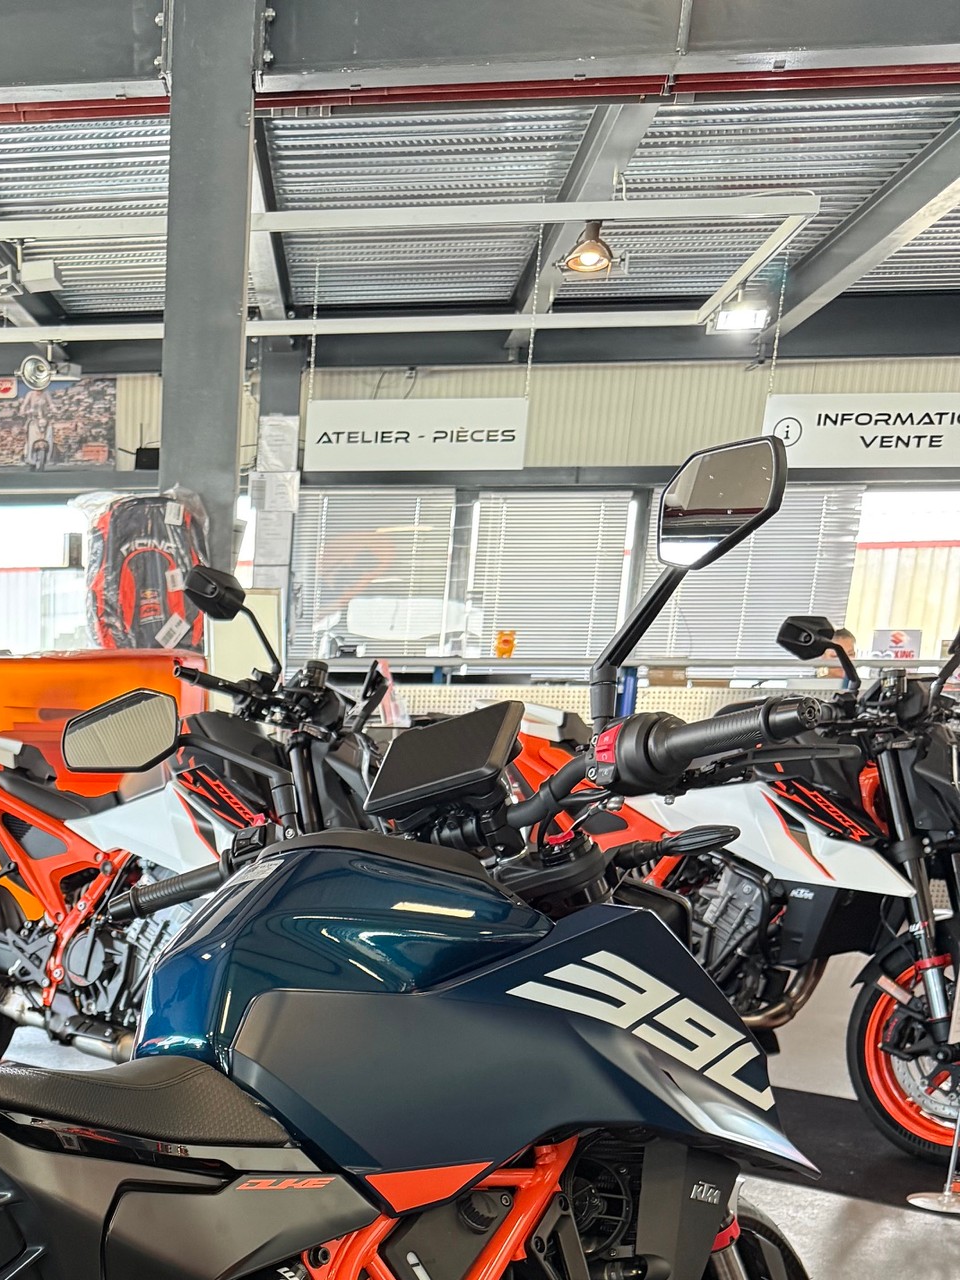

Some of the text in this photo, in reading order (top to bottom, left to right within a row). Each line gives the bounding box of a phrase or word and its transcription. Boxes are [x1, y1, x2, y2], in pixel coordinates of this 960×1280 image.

[816, 412, 960, 426] INFORMATI
[316, 431, 410, 443] ATELIER
[432, 426, 516, 443] PIÈCES
[860, 435, 943, 448] VENTE
[790, 888, 815, 900] KTM
[236, 1177, 337, 1190] DUKE
[690, 1181, 721, 1205] KTM
